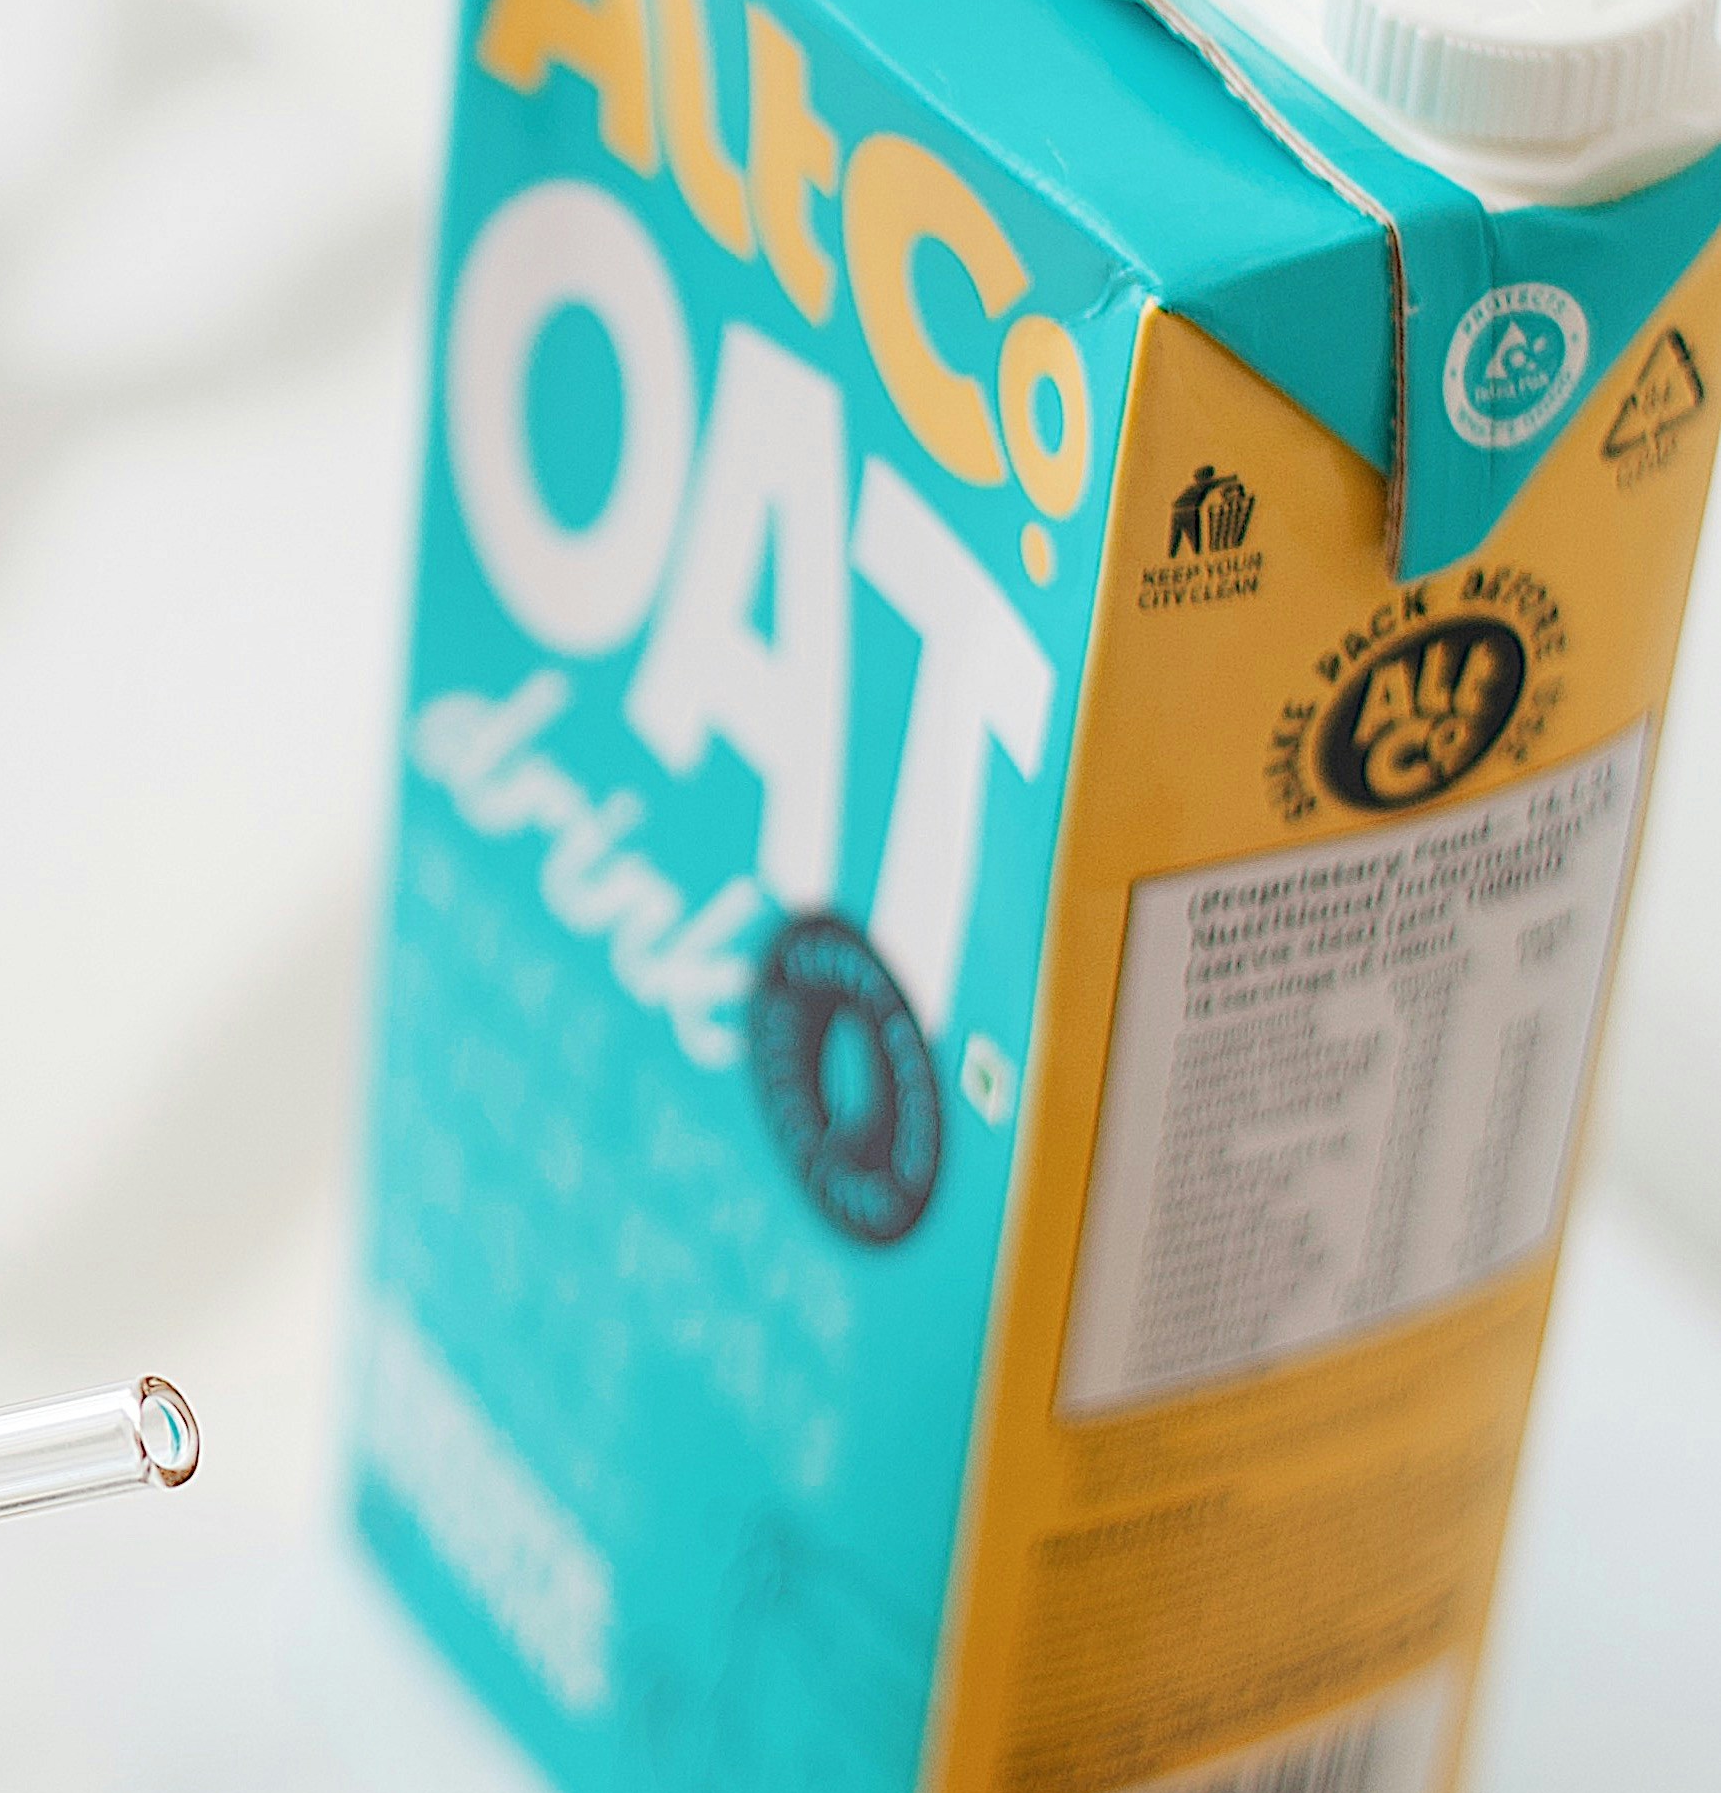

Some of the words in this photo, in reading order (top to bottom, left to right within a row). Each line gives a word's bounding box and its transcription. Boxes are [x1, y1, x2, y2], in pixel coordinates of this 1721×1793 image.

[444, 174, 1056, 1038] OAT
[1137, 581, 1186, 609] CITY
[1189, 574, 1259, 604] CLEAN
[1142, 564, 1201, 586] KEEP
[1204, 551, 1263, 578] YOUR
[1315, 581, 1429, 684] PACK
[409, 666, 766, 1070] drink
